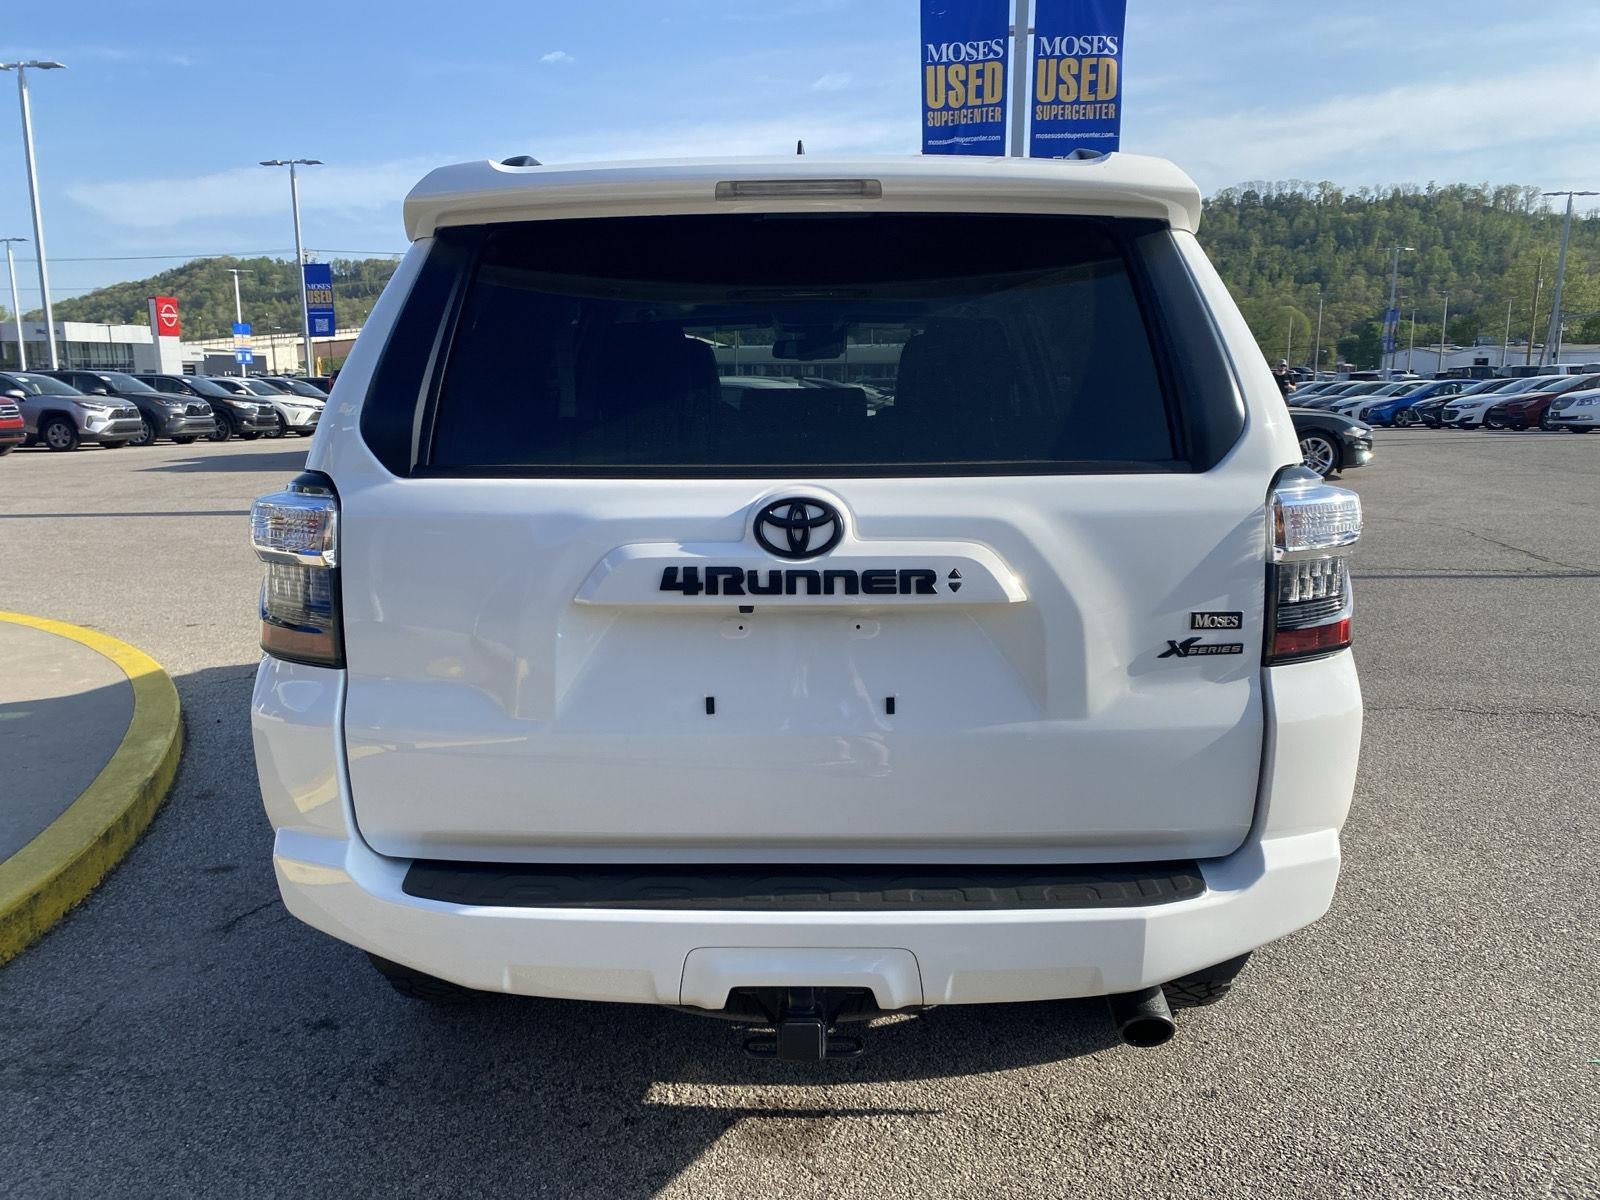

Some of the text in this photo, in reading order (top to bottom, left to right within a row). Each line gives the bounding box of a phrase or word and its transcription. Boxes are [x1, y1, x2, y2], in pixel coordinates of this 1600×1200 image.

[926, 38, 1004, 63] MOSES
[1038, 35, 1118, 56] MOSES
[926, 61, 1003, 109] USED
[1036, 57, 1118, 102] USED
[927, 107, 1001, 127] SUPERCENTER
[1035, 103, 1116, 121] SUPERCENTER
[307, 290, 332, 303] USED
